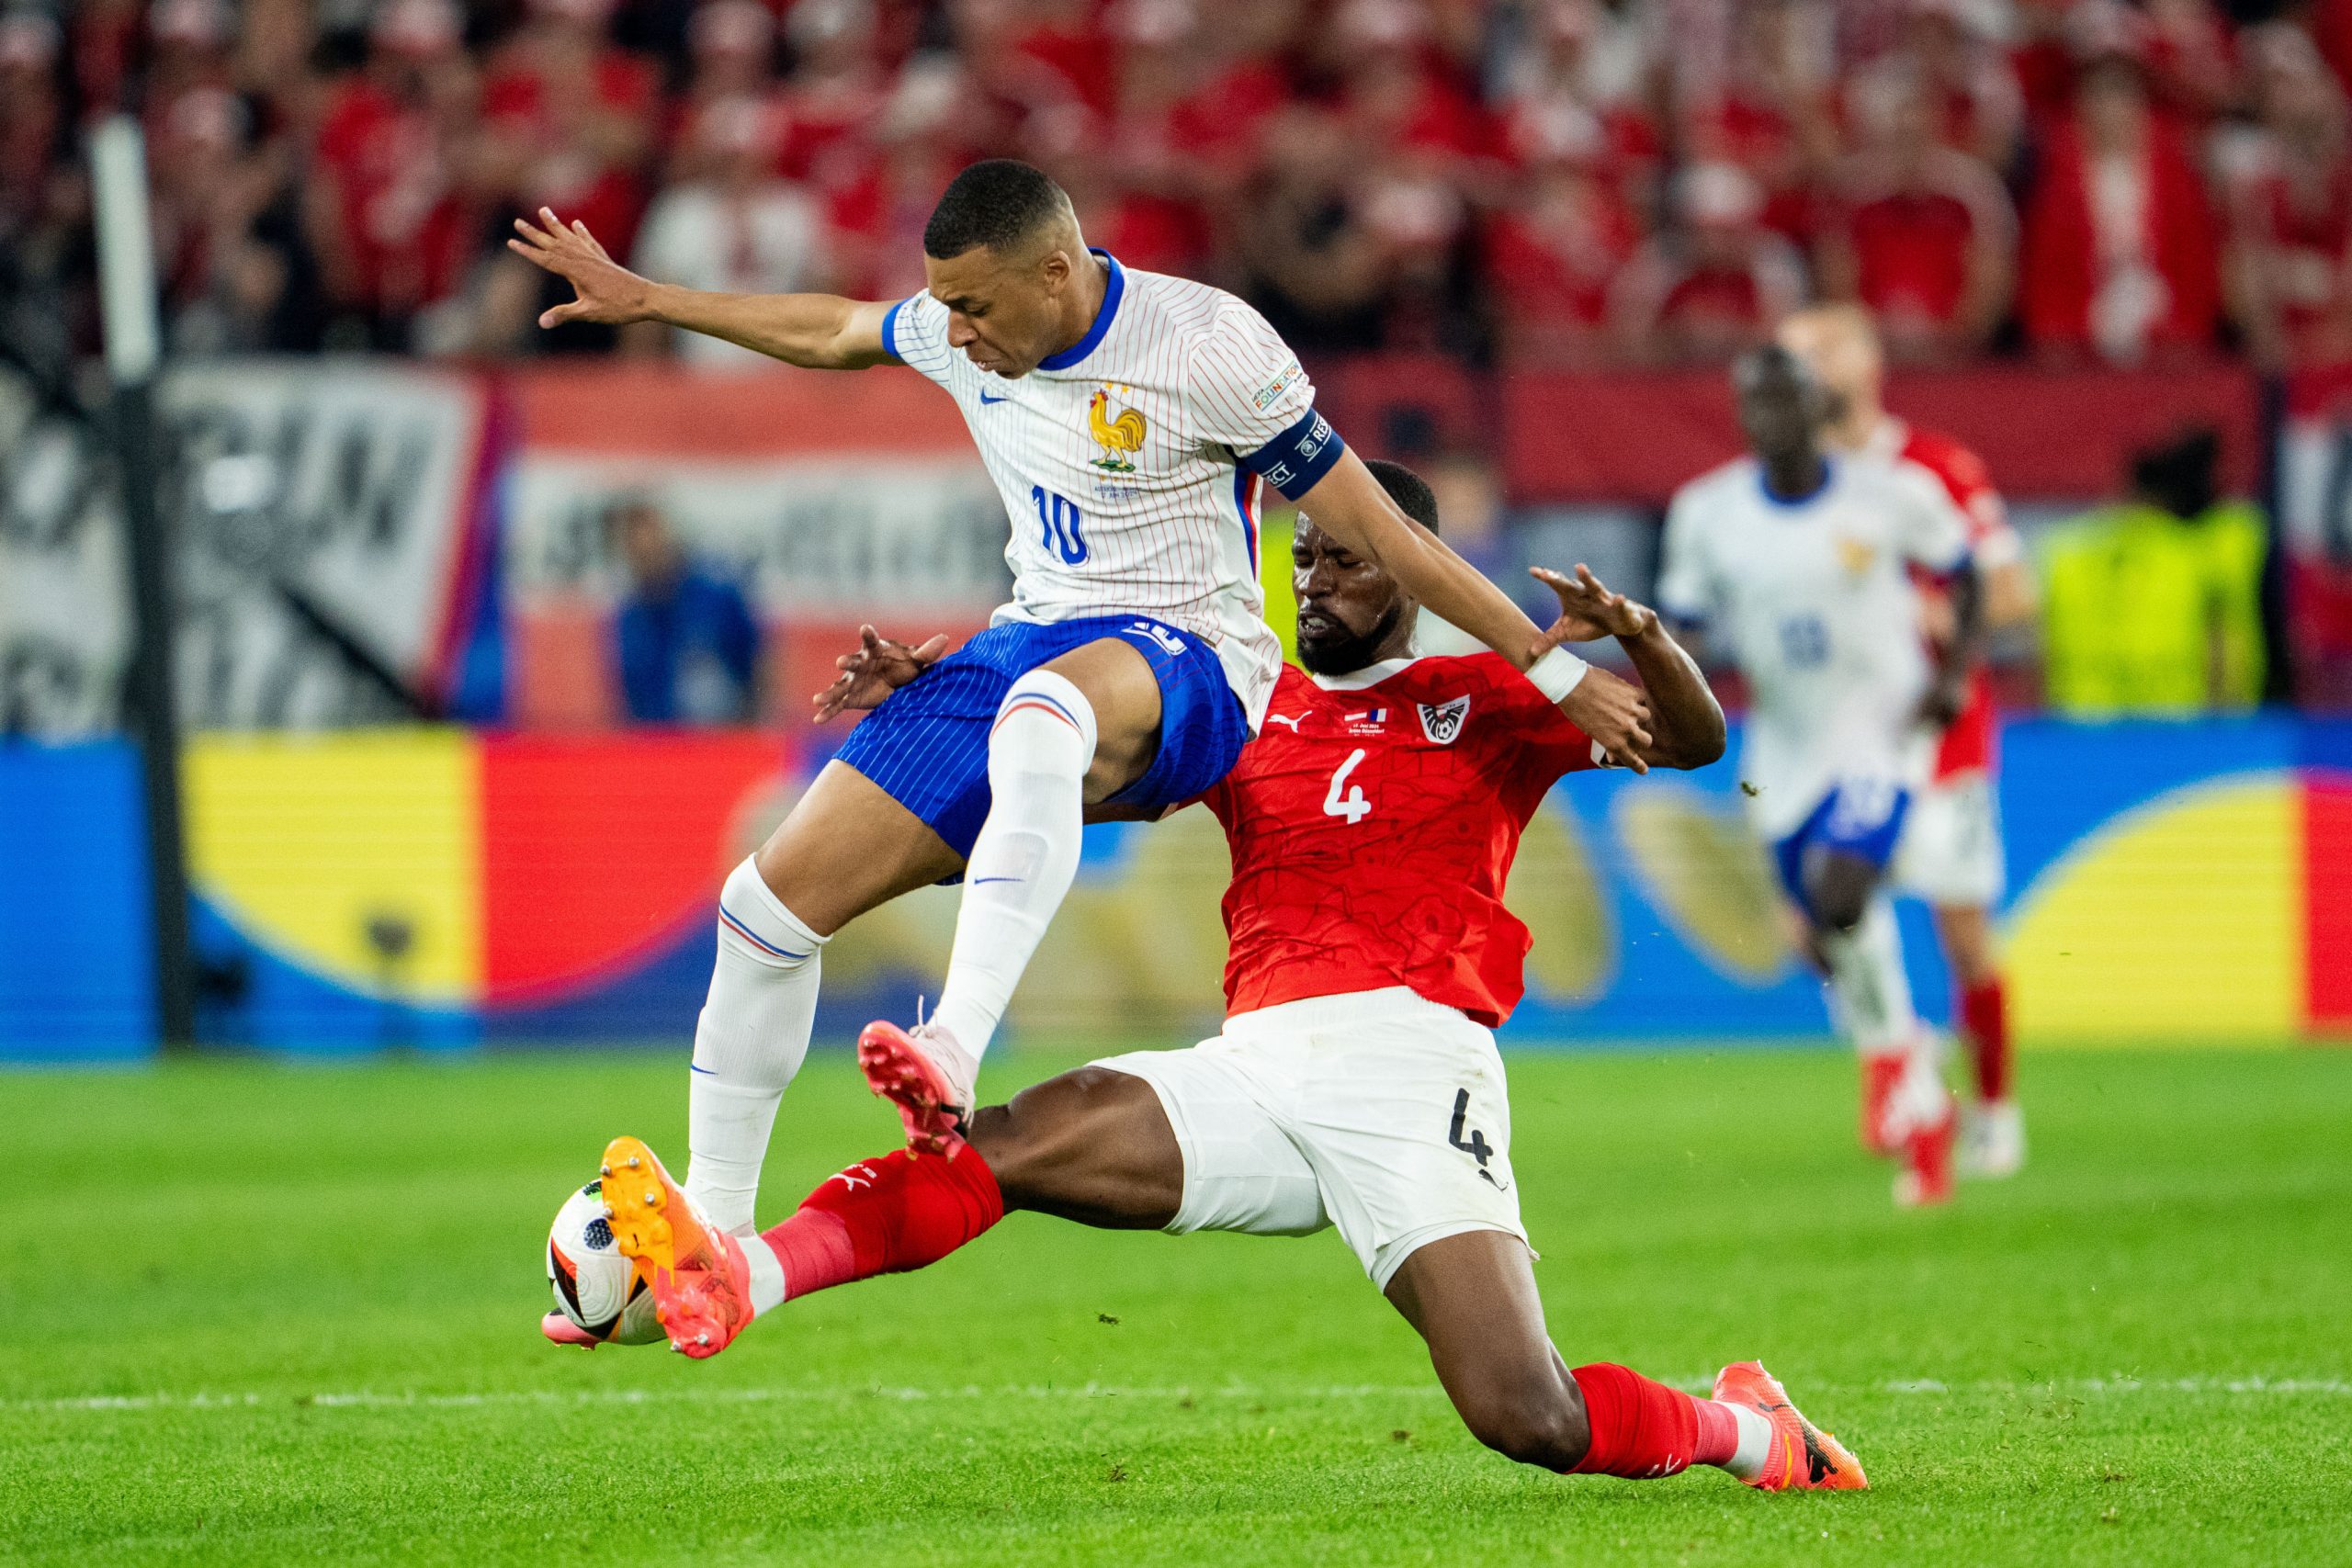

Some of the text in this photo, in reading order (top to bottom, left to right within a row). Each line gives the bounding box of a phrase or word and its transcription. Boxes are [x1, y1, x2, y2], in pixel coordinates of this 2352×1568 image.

[1251, 388, 1265, 402] UEFA
[1255, 362, 1300, 410] FOUNDATION
[1032, 485, 1091, 568] 10
[1323, 749, 1372, 825] 4
[1449, 1088, 1494, 1167] 4
